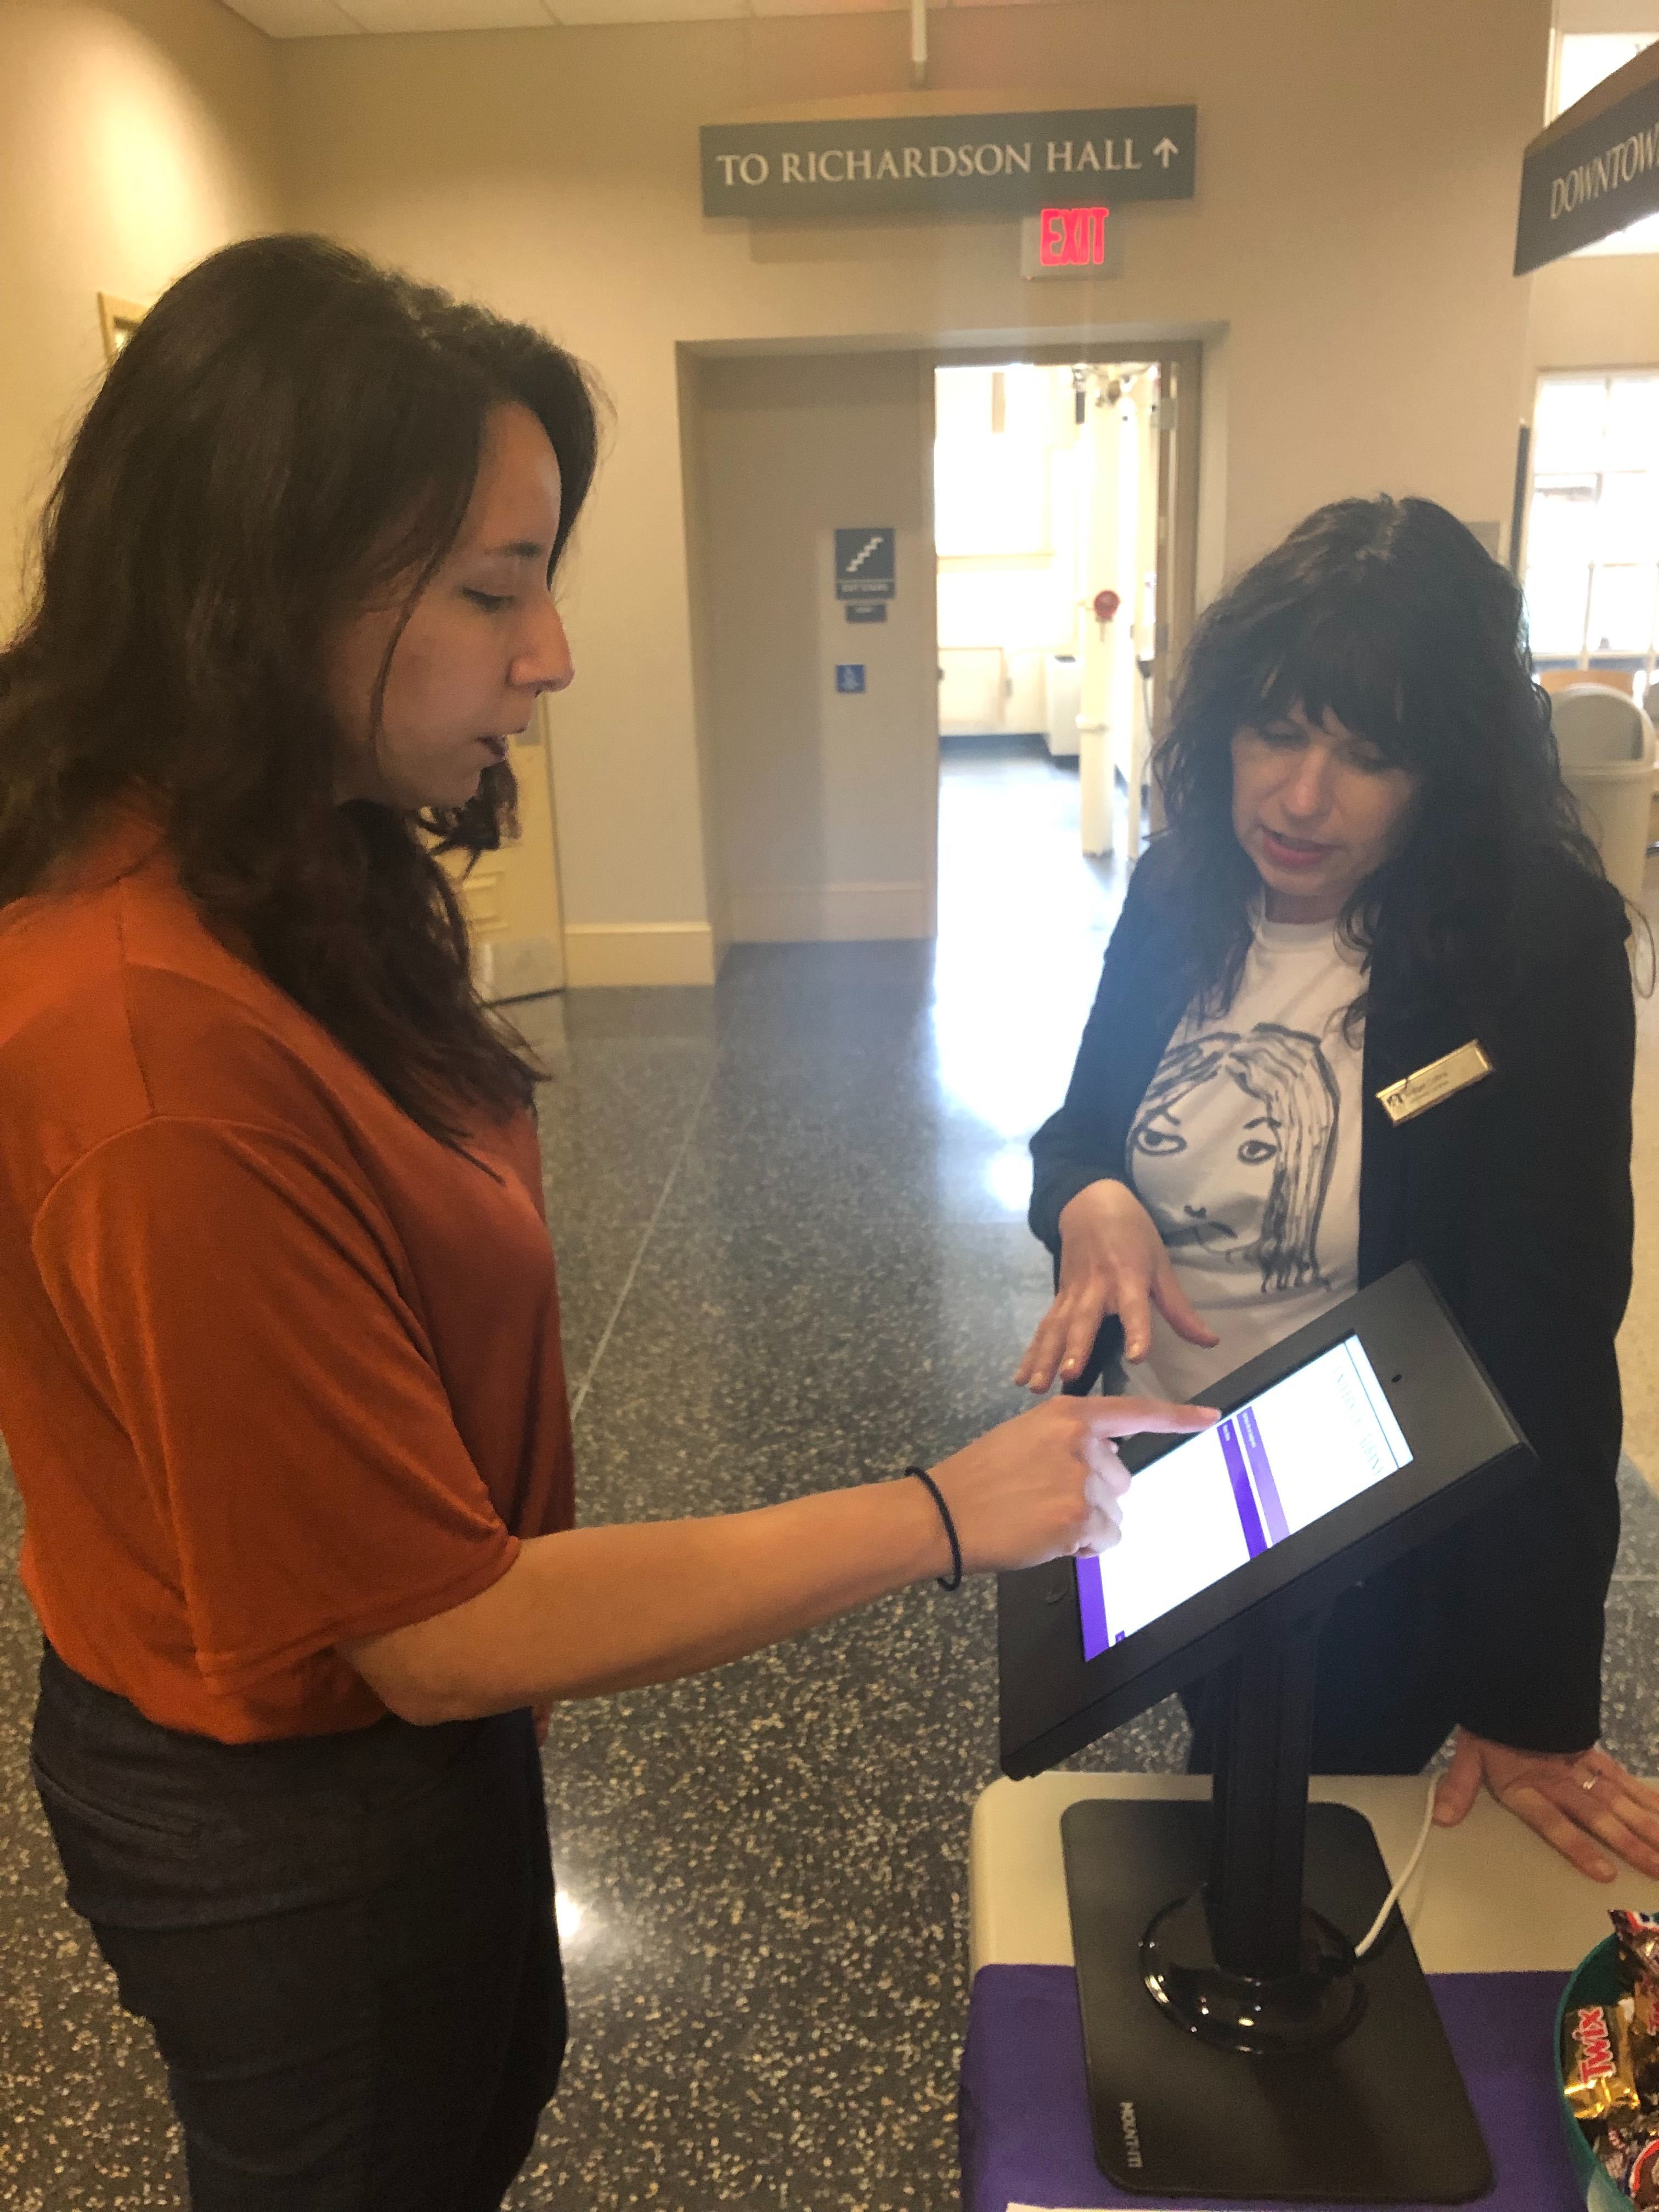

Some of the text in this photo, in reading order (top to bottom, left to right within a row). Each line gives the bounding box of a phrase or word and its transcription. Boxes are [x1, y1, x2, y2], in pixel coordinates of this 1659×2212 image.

[716, 137, 1142, 185] TO RICHARDSON HALL
[1549, 122, 1659, 220] DOWNTOW
[1039, 207, 1109, 266] EXIT
